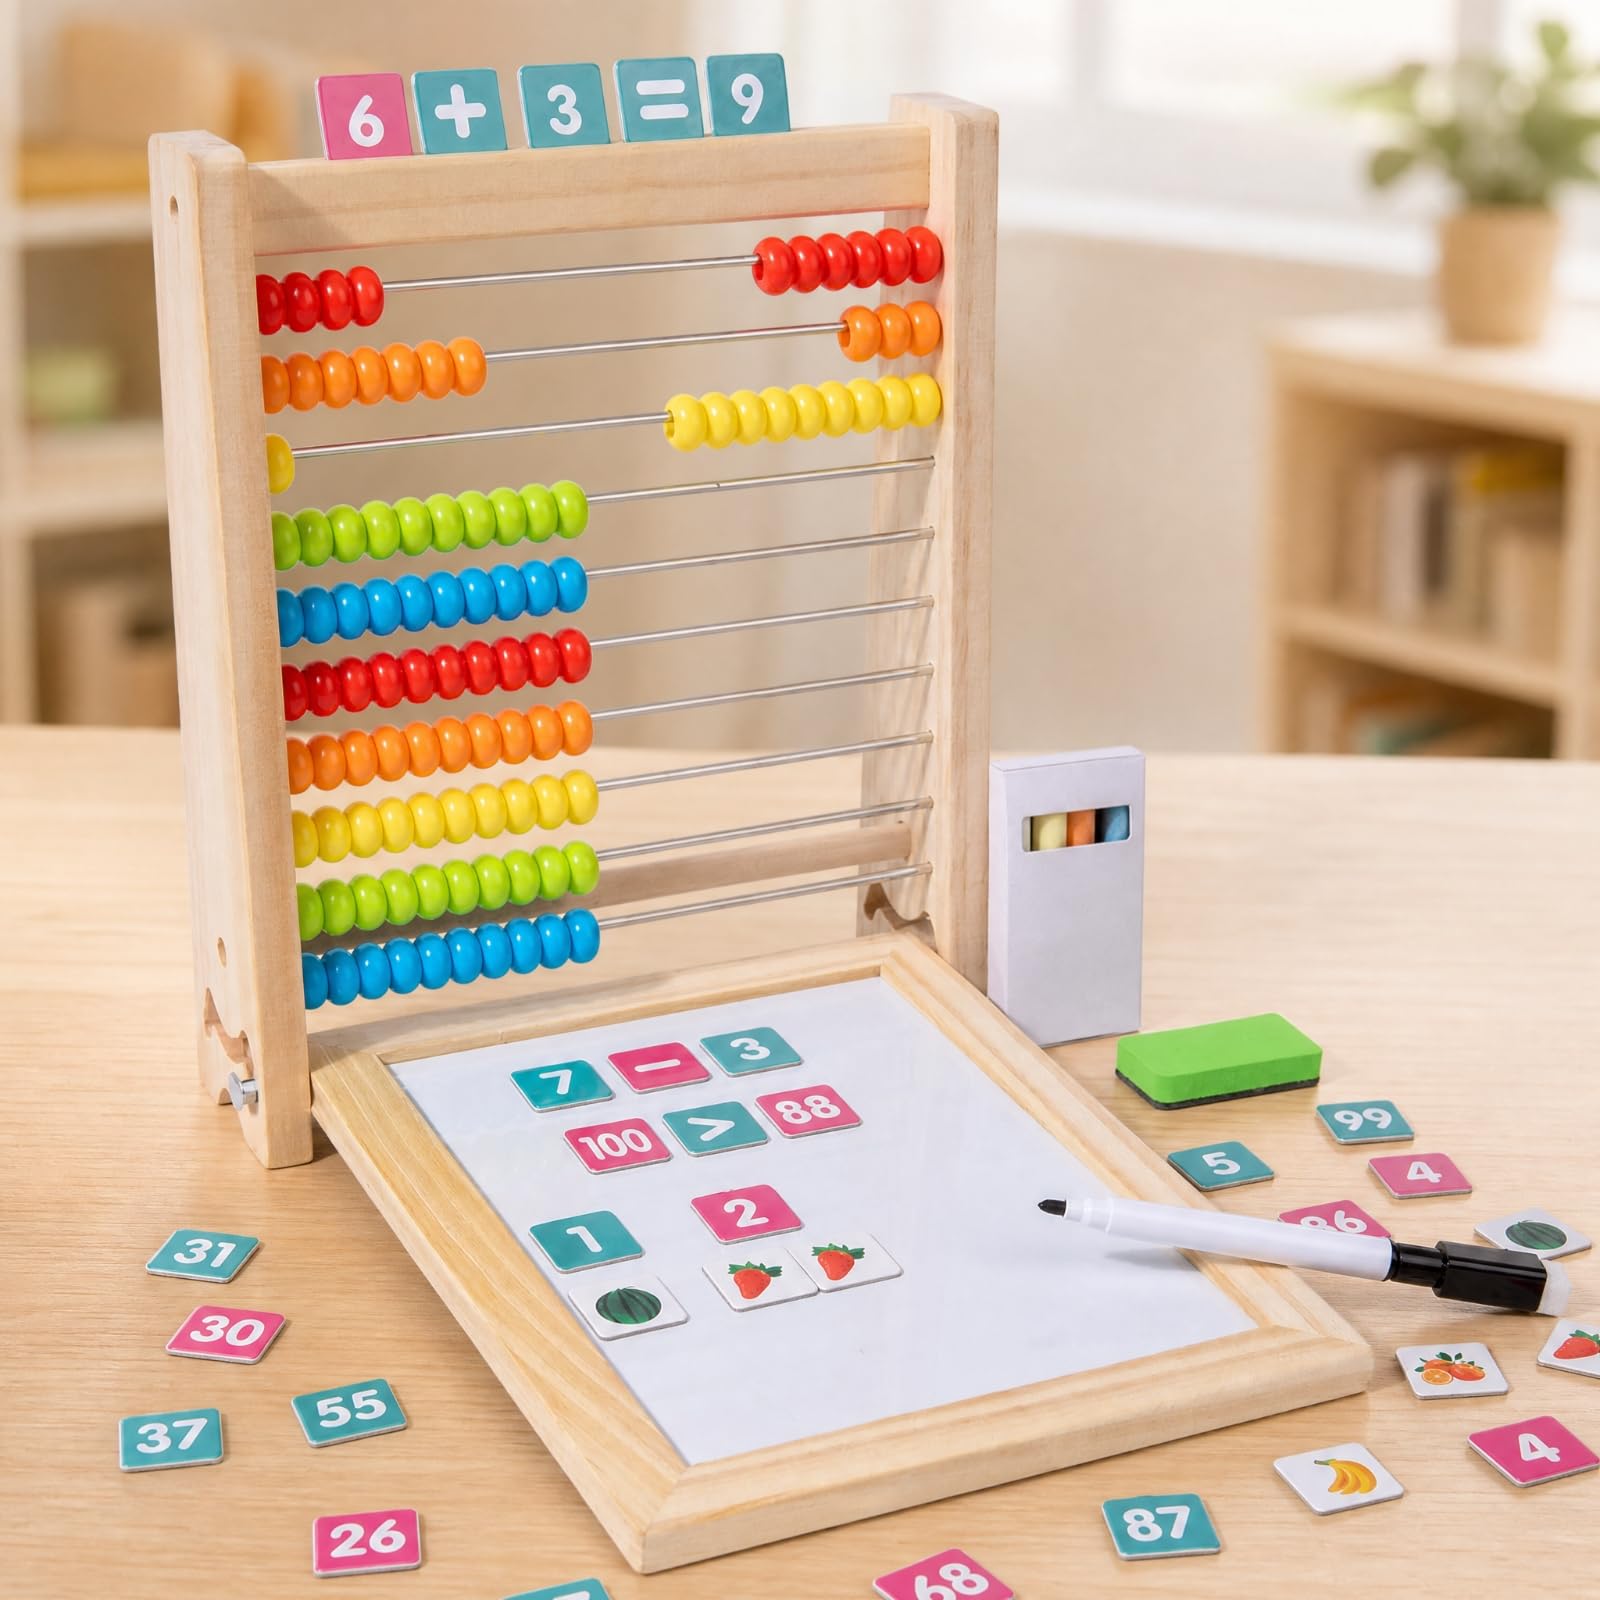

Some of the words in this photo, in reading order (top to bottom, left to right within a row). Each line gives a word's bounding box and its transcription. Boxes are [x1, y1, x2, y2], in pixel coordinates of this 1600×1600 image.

[349, 95, 384, 147] 6
[434, 83, 487, 139] +
[547, 84, 582, 137] 3
[635, 79, 689, 120] =
[731, 71, 764, 125] 9
[540, 1069, 572, 1094] 7
[730, 1037, 770, 1062] 3
[578, 1128, 652, 1160] 100
[687, 1117, 735, 1141] >
[775, 1095, 841, 1125] 88
[1334, 1107, 1392, 1132] 99
[1202, 1152, 1240, 1175] 5
[1407, 1161, 1442, 1183] 4
[724, 1199, 768, 1227] 2
[174, 1238, 236, 1267] 31
[566, 1226, 602, 1252] 1
[190, 1315, 264, 1346] 30
[316, 1390, 387, 1428] 55
[137, 1418, 208, 1453] 37
[1519, 1433, 1560, 1462] 4
[331, 1520, 405, 1557] 26
[1123, 1505, 1190, 1542] 87
[915, 1563, 989, 1600] 68
